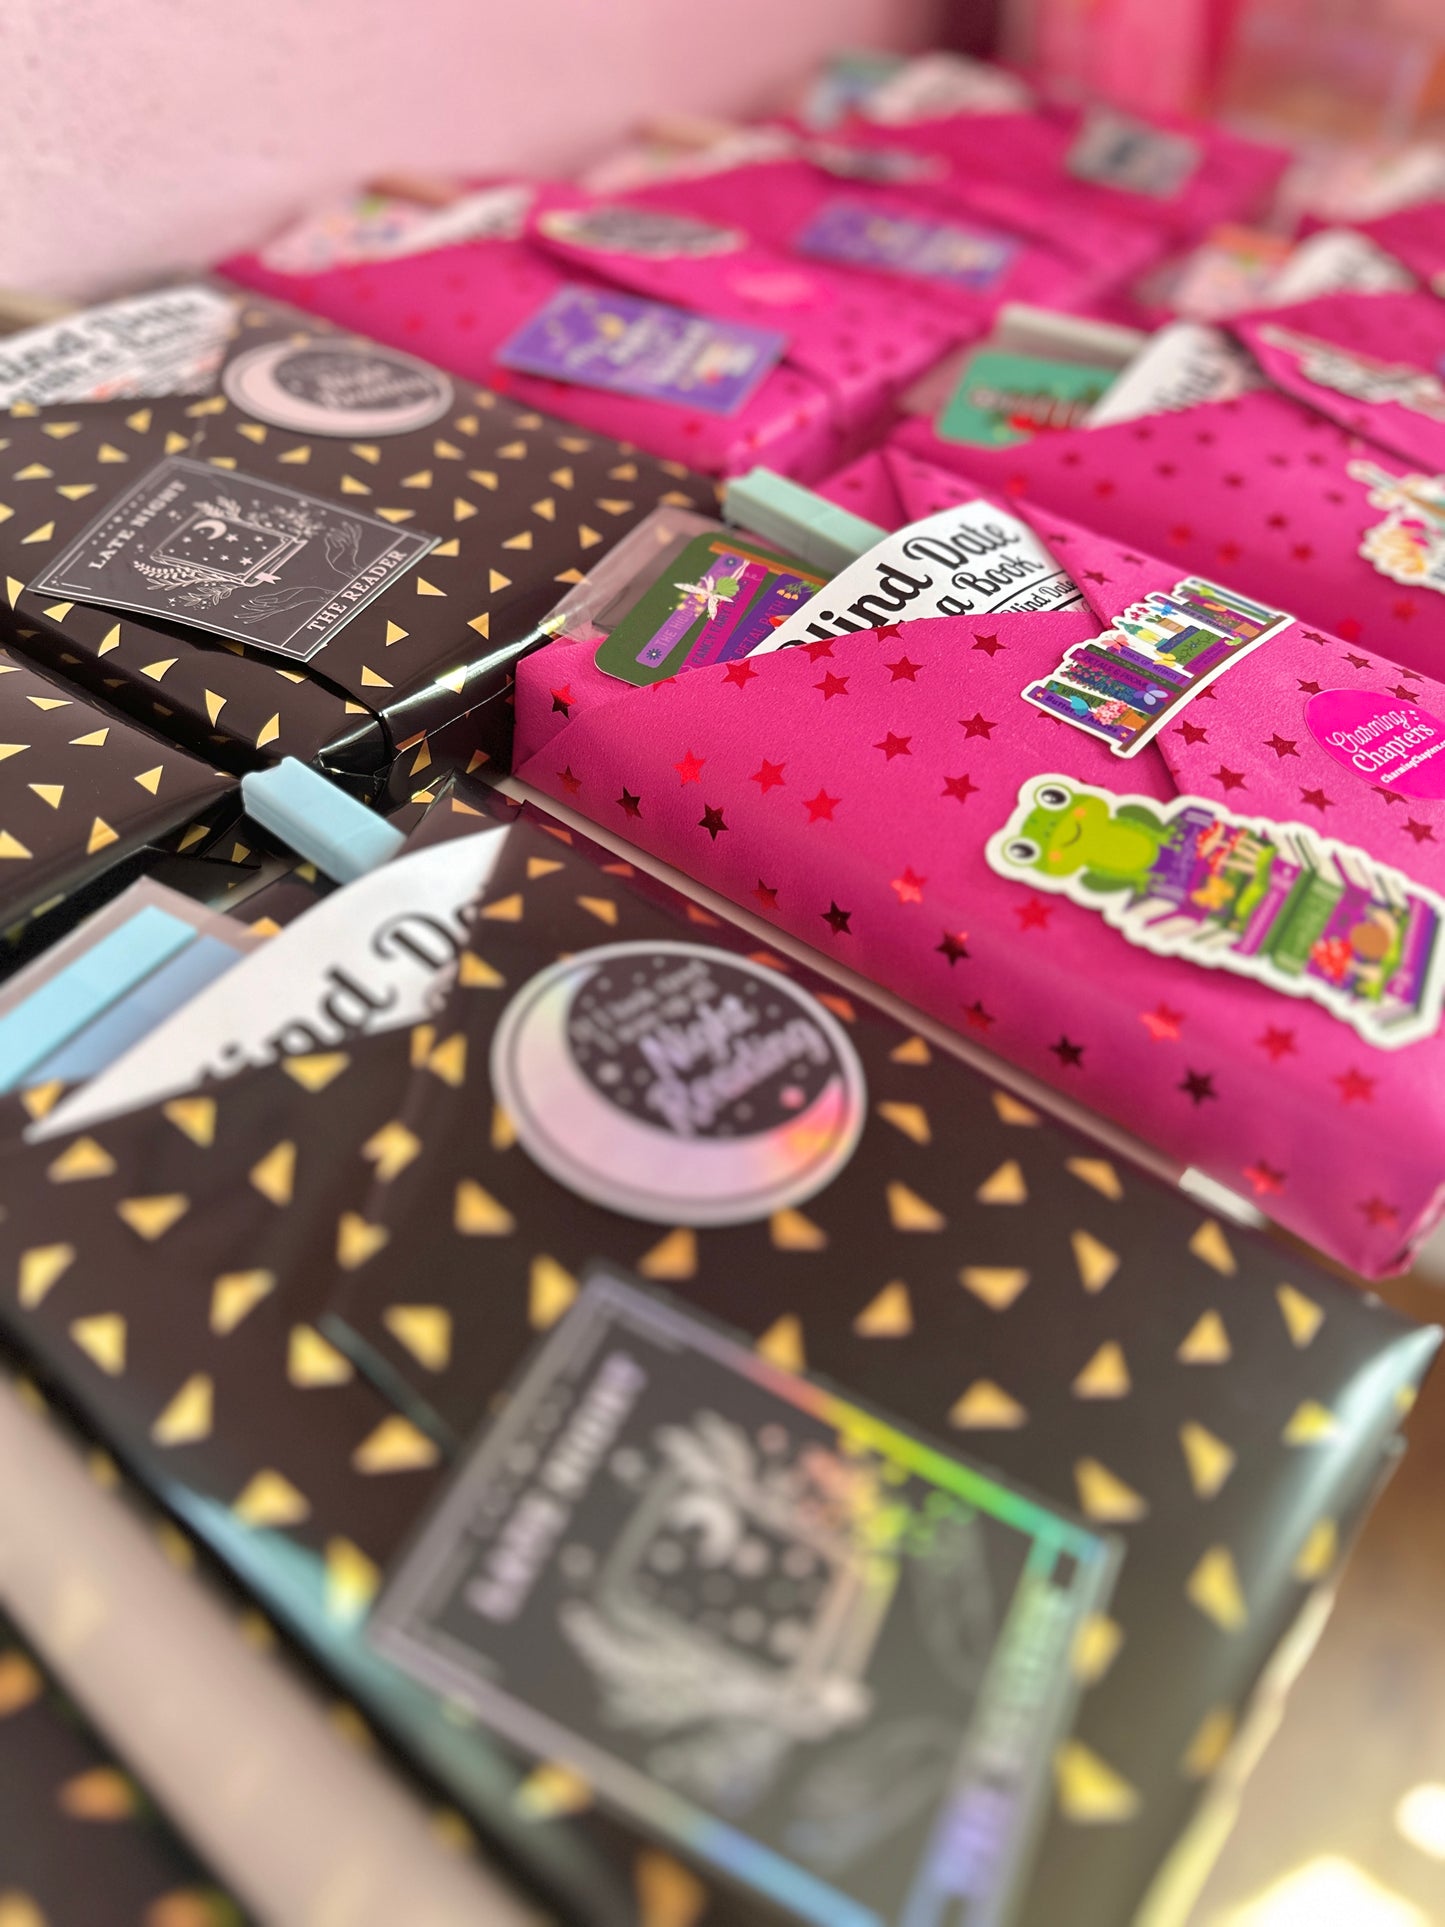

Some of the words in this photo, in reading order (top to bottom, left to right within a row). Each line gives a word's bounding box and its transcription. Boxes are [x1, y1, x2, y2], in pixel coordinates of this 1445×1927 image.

[88, 529, 136, 569] LATE
[307, 602, 348, 632] THE
[341, 549, 408, 602] READER
[777, 561, 934, 650] lind
[902, 522, 1021, 571] Date
[951, 549, 1045, 598] Book
[935, 593, 975, 617] a
[654, 630, 677, 648] THE
[691, 637, 715, 664] FANCY
[734, 625, 767, 655] PETAL
[1325, 710, 1411, 753] Charming
[1352, 724, 1435, 772] Chapters
